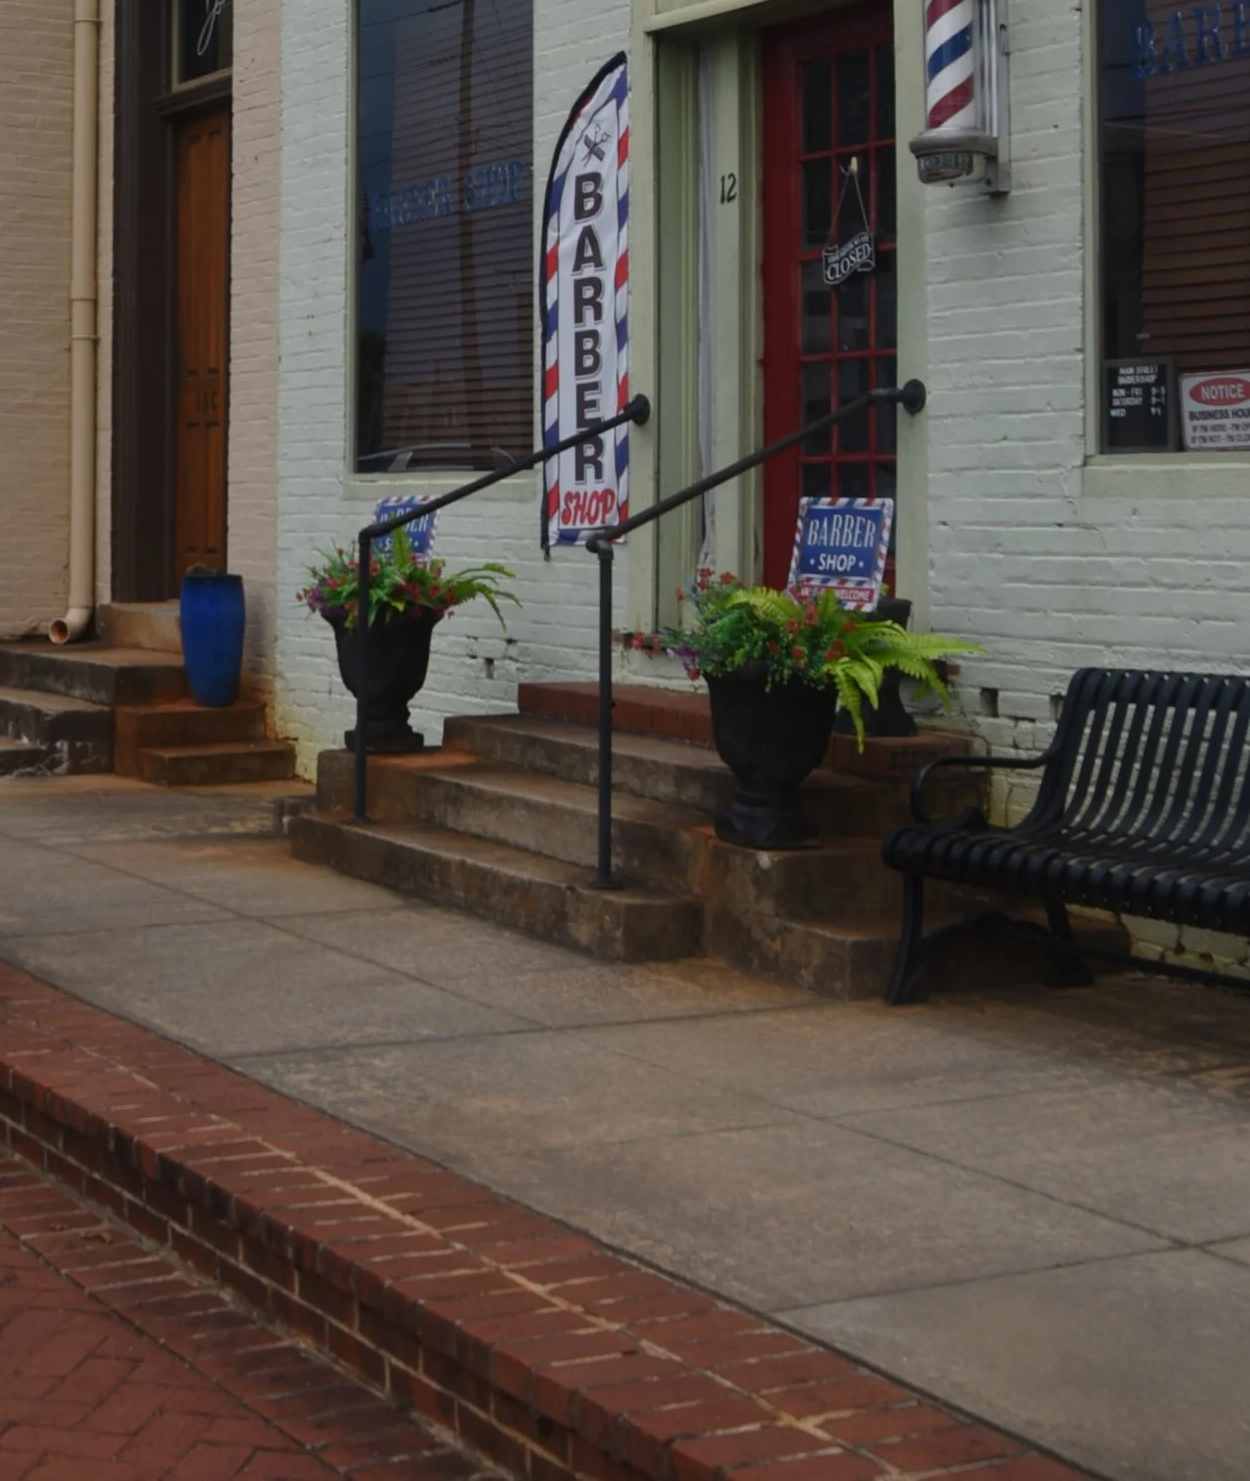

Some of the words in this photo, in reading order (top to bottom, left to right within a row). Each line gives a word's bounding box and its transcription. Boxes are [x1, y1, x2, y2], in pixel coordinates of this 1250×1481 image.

[720, 172, 737, 205] 12
[826, 243, 871, 280] CLOSED
[571, 170, 607, 486] BARBER
[1200, 383, 1245, 401] NOTICE
[1188, 409, 1229, 421] BUSINESS
[561, 488, 617, 527] SHOP
[807, 514, 877, 548] BARBER
[818, 553, 856, 572] SHOP
